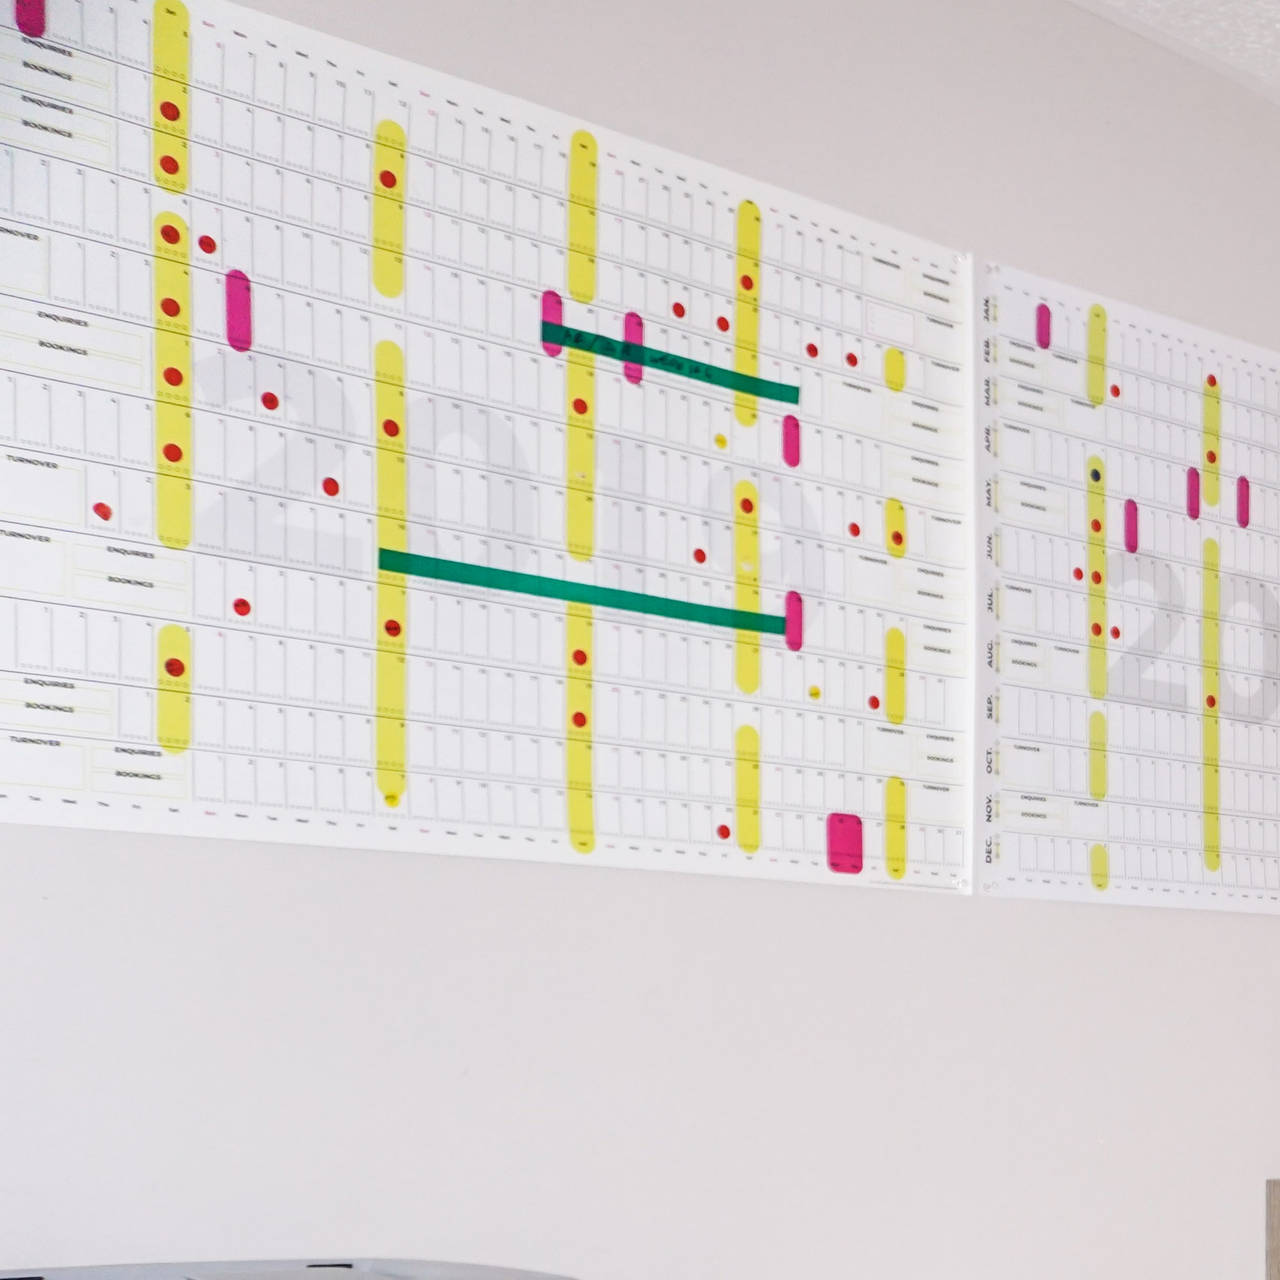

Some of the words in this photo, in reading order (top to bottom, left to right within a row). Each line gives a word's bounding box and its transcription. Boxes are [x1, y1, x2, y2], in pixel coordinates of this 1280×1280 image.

[22, 61, 73, 82] BOOKINGS
[21, 95, 74, 115] ENQUIRIES
[22, 119, 73, 139] BOOKINGS
[37, 310, 89, 328] ENQUIRIES
[38, 340, 89, 357] BOOKINGS
[6, 453, 59, 470] TURNOVER
[107, 545, 155, 560] ENQUIRIES
[107, 575, 154, 589] BOOKINGS
[24, 677, 75, 690] ENQUIRIES
[24, 702, 75, 714] BOOKINGS
[10, 735, 61, 747] TURNOVER
[115, 747, 162, 757] ENQUIRIES
[115, 771, 162, 780] BOOKINGS
